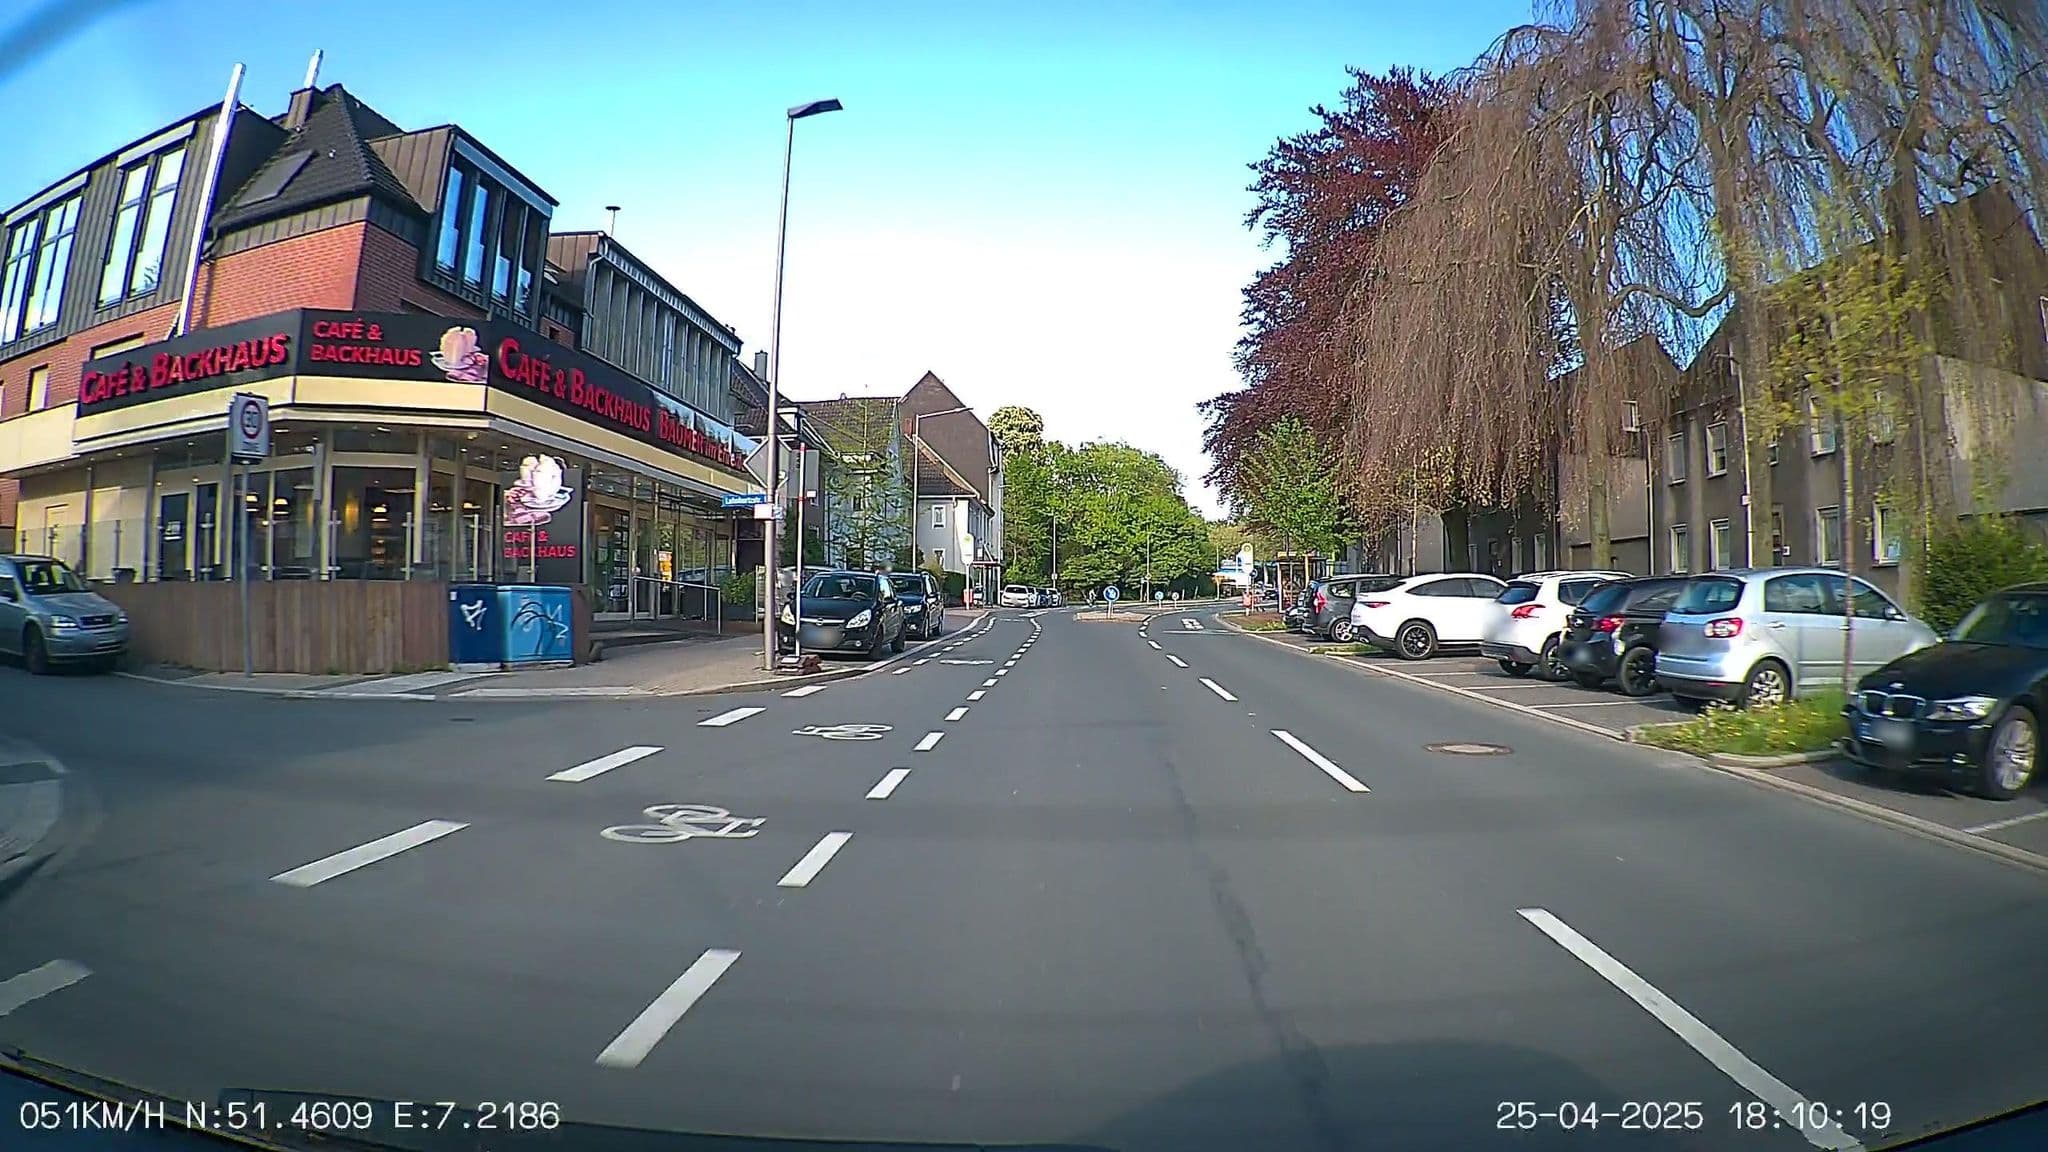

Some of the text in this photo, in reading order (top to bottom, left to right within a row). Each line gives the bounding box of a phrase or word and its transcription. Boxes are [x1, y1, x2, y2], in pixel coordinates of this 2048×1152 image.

[313, 317, 383, 340] CAFÉ &
[310, 344, 422, 366] BACKHAUS
[80, 333, 289, 404] CAFÉ & BACKHAUS
[498, 336, 652, 432] CAFÉ & BACKHAUS
[538, 530, 550, 542] &
[504, 545, 577, 559] BACHAUS
